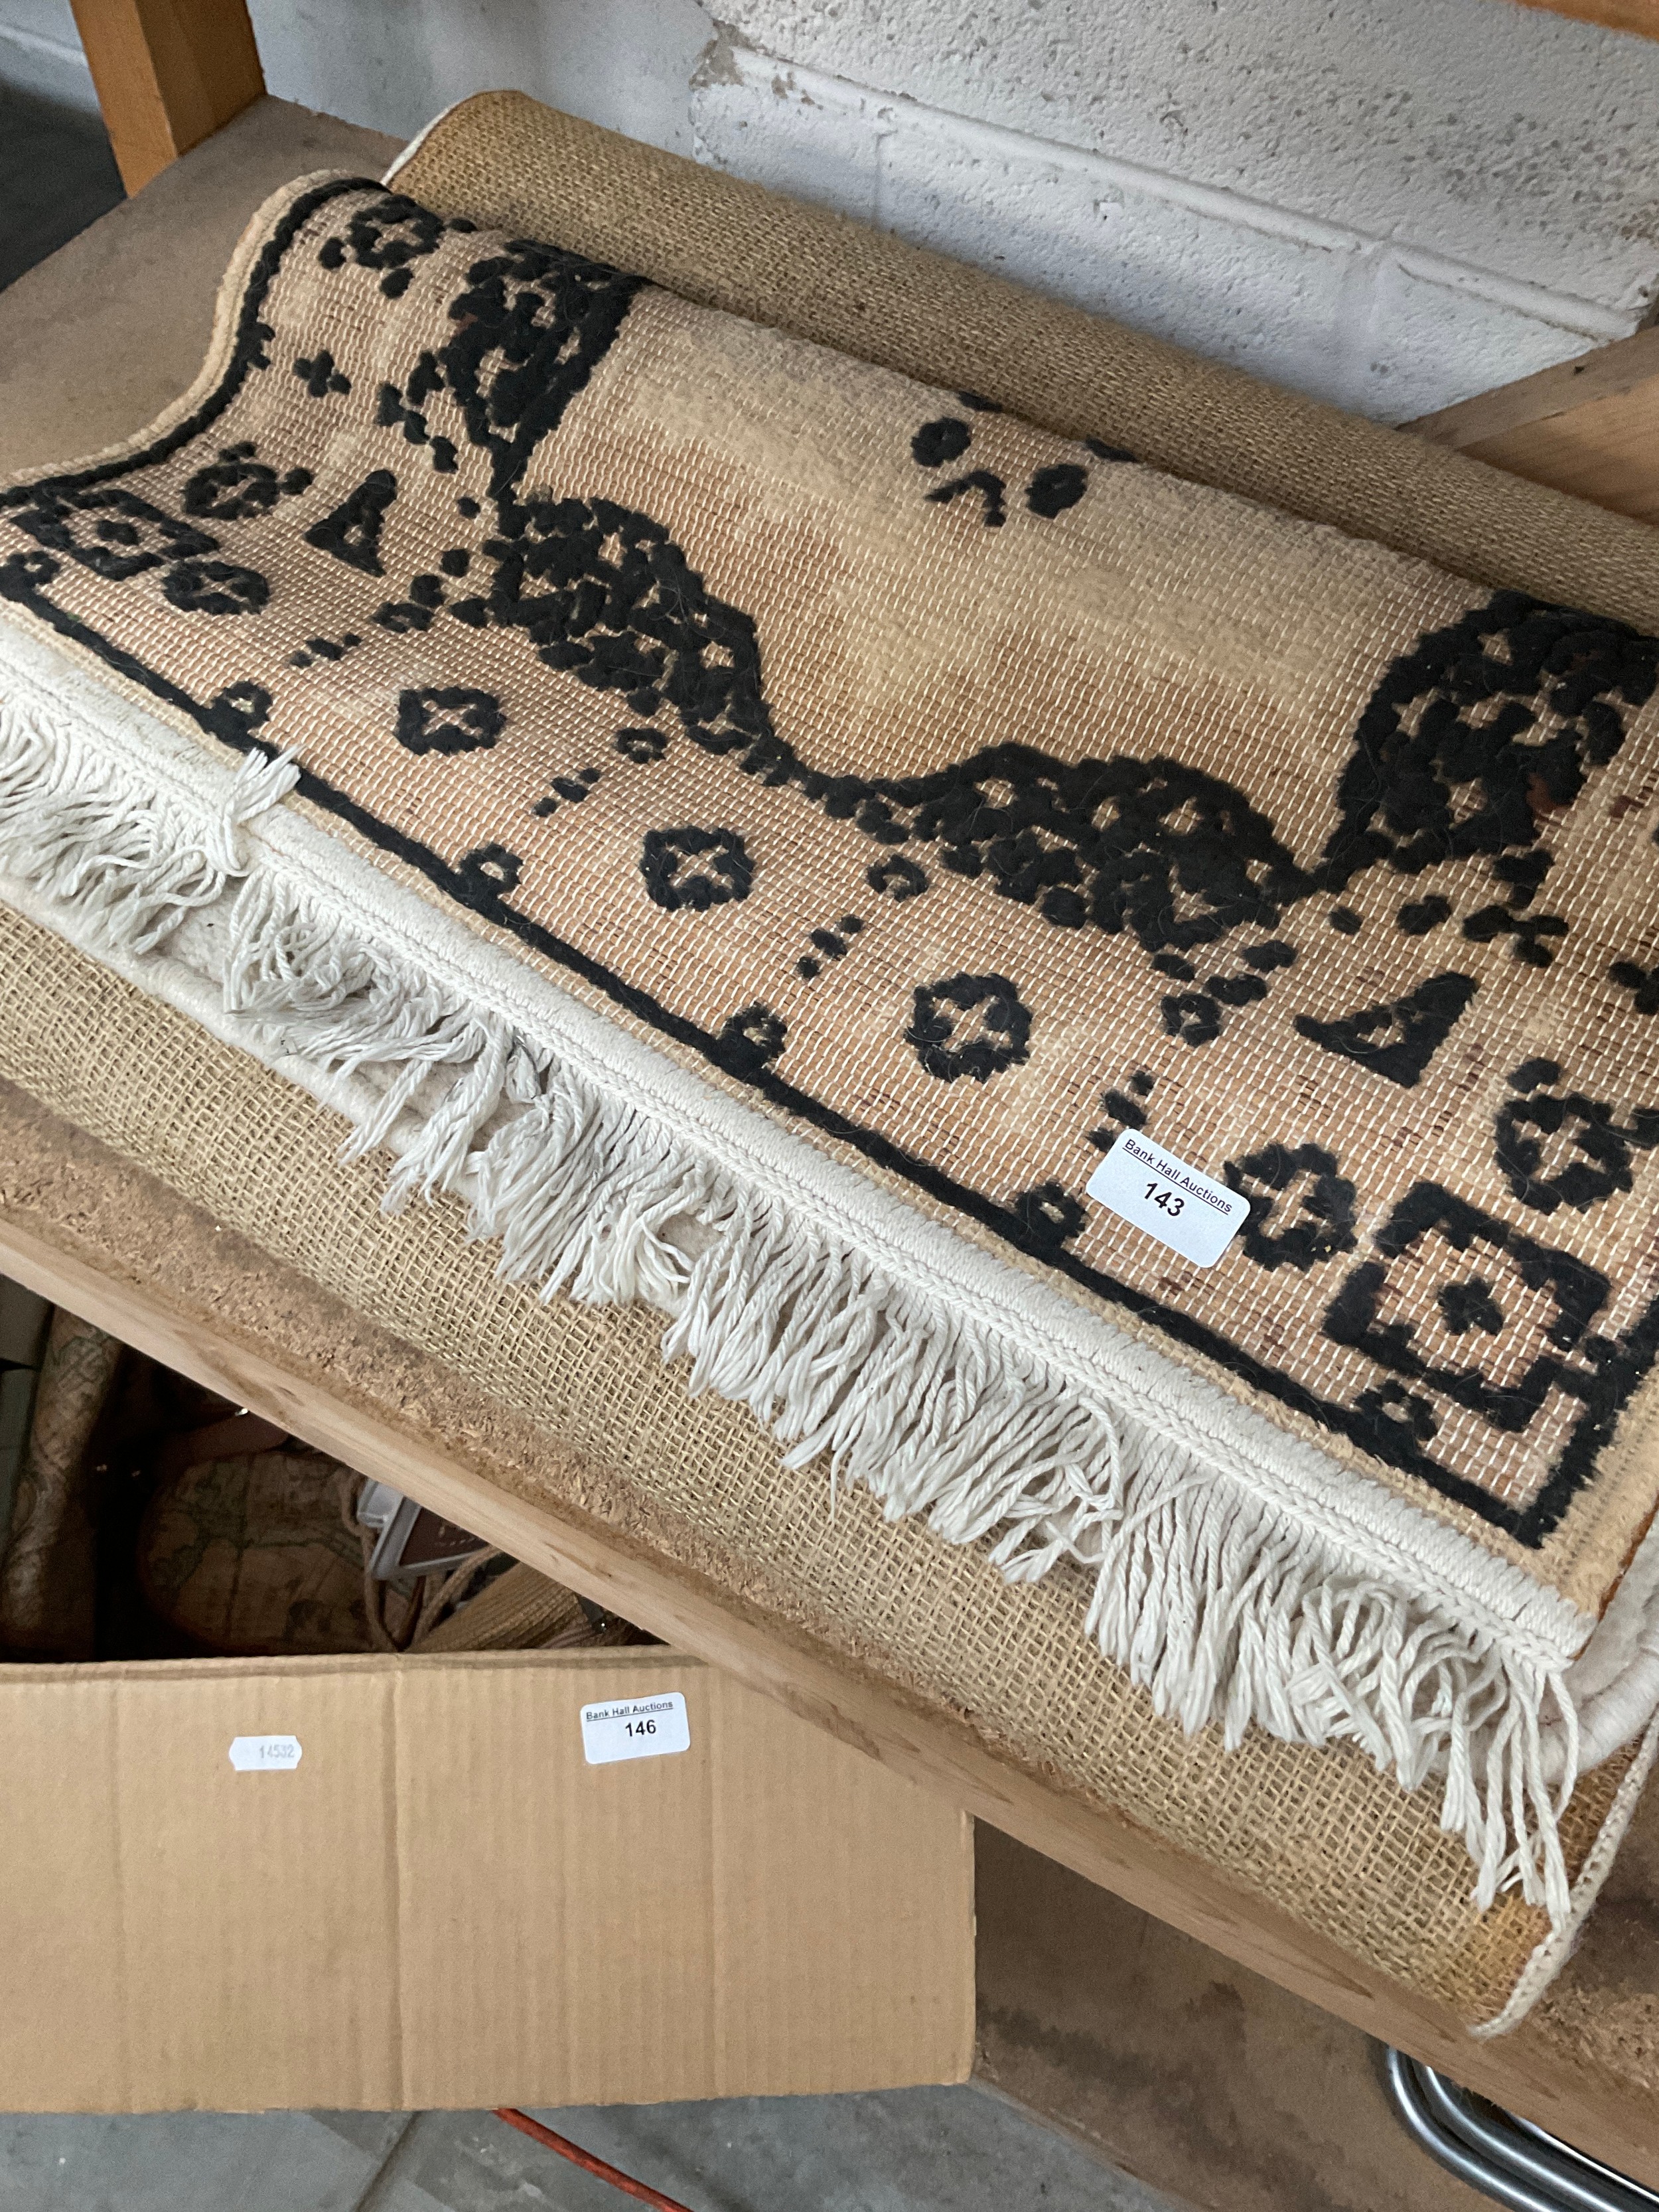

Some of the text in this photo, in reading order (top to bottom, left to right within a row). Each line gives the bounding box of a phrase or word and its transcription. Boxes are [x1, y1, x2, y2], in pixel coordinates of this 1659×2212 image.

[1124, 1138, 1233, 1213] Bank Hall Auctions
[1144, 1182, 1185, 1217] 143
[586, 1701, 673, 1720] Bank Hall Auctions
[625, 1719, 656, 1737] 146
